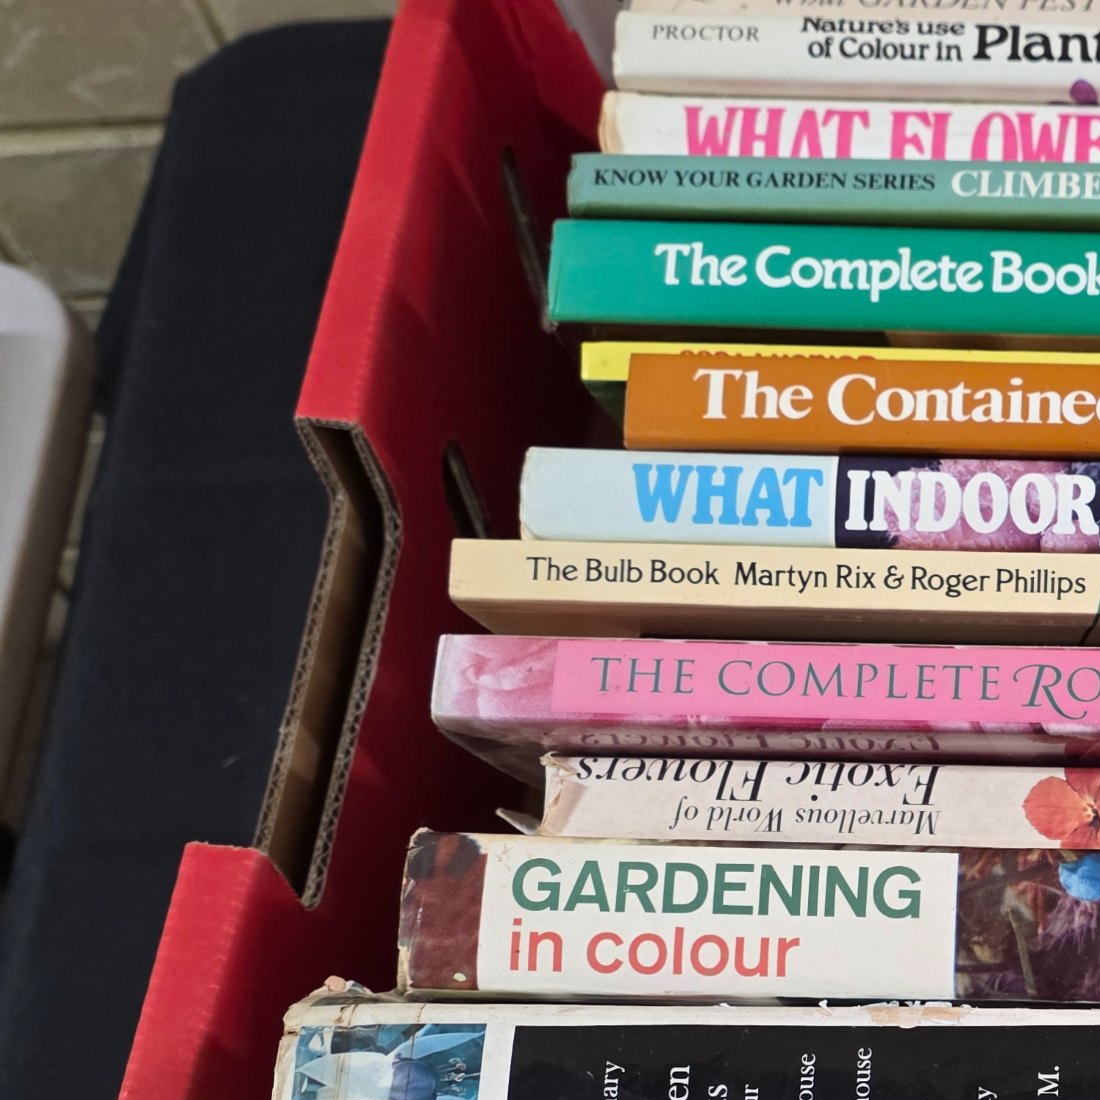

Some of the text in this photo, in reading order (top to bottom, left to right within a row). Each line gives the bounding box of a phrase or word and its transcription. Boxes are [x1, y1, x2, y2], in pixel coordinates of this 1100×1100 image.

[652, 24, 760, 42] PROCTOR
[801, 17, 966, 36] Nature's use
[807, 38, 963, 61] of Colour in
[684, 106, 870, 158] WHAT
[593, 168, 937, 192] KNOW YOUR GARDEN SERIES
[655, 242, 747, 286] The
[755, 246, 984, 304] Complete
[694, 367, 813, 420] The
[633, 463, 823, 528] WHAT
[846, 470, 1100, 536] INDOOR
[527, 557, 1087, 600] The Bulb Book Martyn Rix & Roger Phillips
[591, 655, 696, 695] THE
[718, 658, 1000, 701] COMPLETE
[576, 755, 947, 807] Exotic Flowers
[669, 797, 941, 836] Marvellous World of
[510, 857, 922, 919] GARDENING
[508, 918, 800, 978] in colour
[1038, 1065, 1061, 1097] M.
